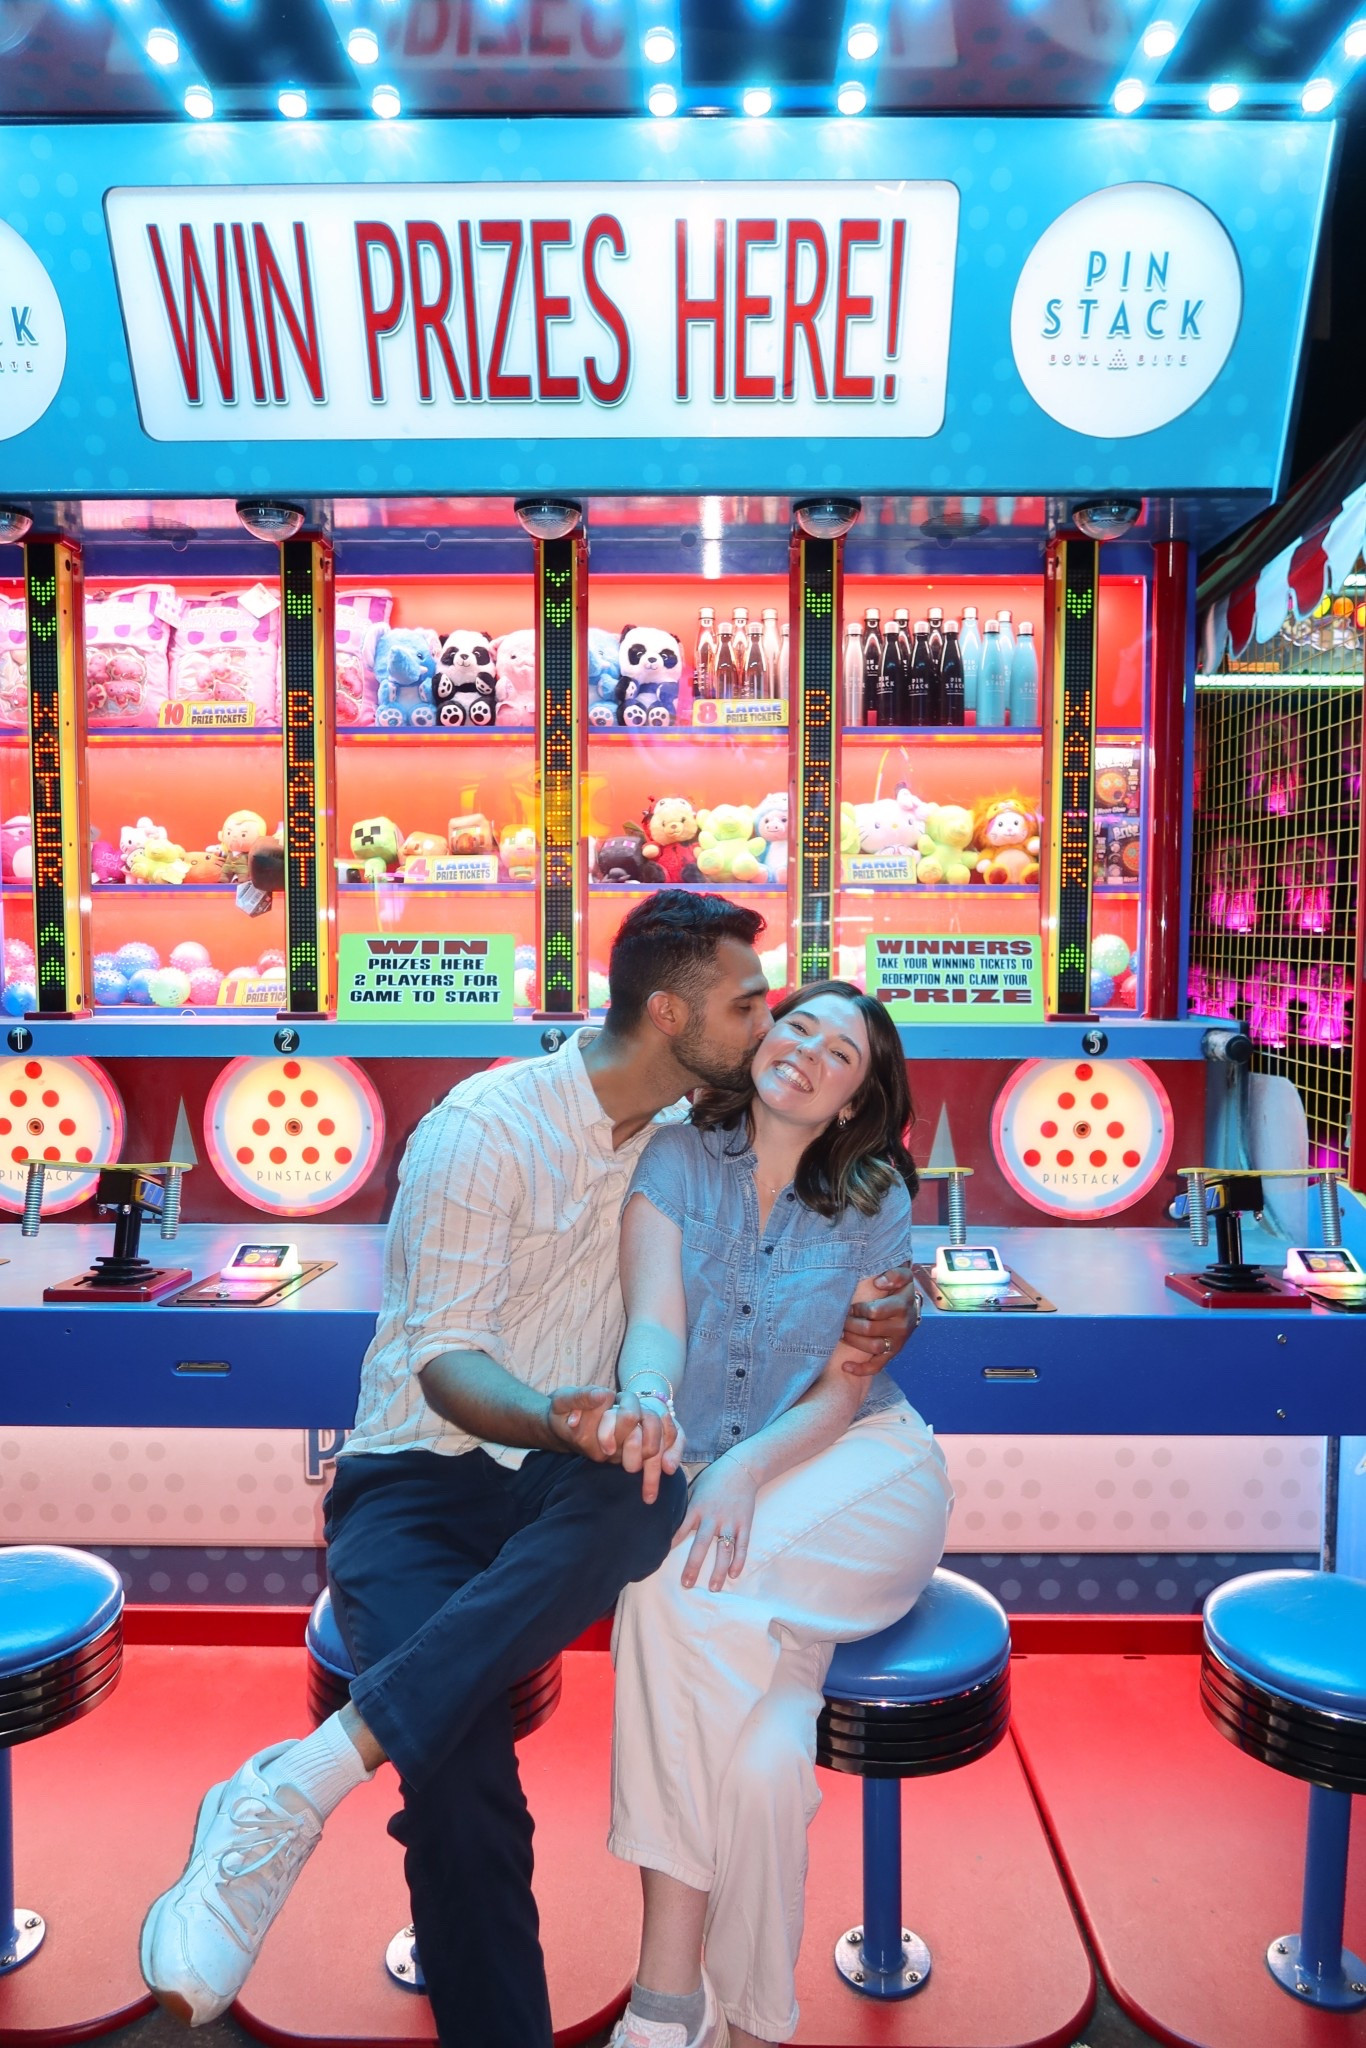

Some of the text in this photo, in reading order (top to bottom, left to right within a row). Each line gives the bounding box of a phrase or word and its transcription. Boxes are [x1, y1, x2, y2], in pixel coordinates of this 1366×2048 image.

[1085, 250, 1170, 289] PIN
[146, 213, 907, 405] WIN PRIZES HERE!
[1042, 298, 1204, 337] STACK
[1050, 354, 1187, 363] BOWL BITE
[164, 703, 248, 725] 10 LARGE
[191, 714, 247, 725] PRIZE TICKETS
[697, 702, 782, 724] 8 LARGE
[726, 712, 782, 723] PRIZE TICKETS
[33, 692, 63, 887] WATER
[288, 690, 316, 887] BLAST
[803, 690, 831, 887] BLAST
[1062, 690, 1091, 888] WATER
[101, 852, 119, 862] YOU
[408, 859, 491, 881] 4 LARGE
[852, 861, 907, 870] LARGE
[852, 868, 908, 879] PRIZE TICKETS
[436, 869, 491, 881] PRIZE TICKETS
[366, 940, 488, 955] WIN
[876, 940, 1033, 956] WINNERS
[368, 958, 485, 971] PRIZES HERE
[877, 957, 1033, 970] TAKE YOUR WINNING TICKETS TO
[354, 974, 498, 987] 2 PLAYERS FOR
[882, 973, 1028, 986] REDEMPTION AND CLAIM YOUR
[225, 980, 239, 1004] 1
[246, 992, 269, 1003] PRIZE
[350, 990, 501, 1003] GAME TO START
[876, 988, 1032, 1004] PRIZE
[16, 1031, 24, 1050] 1
[281, 1031, 293, 1051] 2
[547, 1030, 559, 1052] 3
[1089, 1032, 1101, 1054] 5
[256, 1170, 332, 1182] PINSTACK
[1043, 1173, 1120, 1185] PINSTACK
